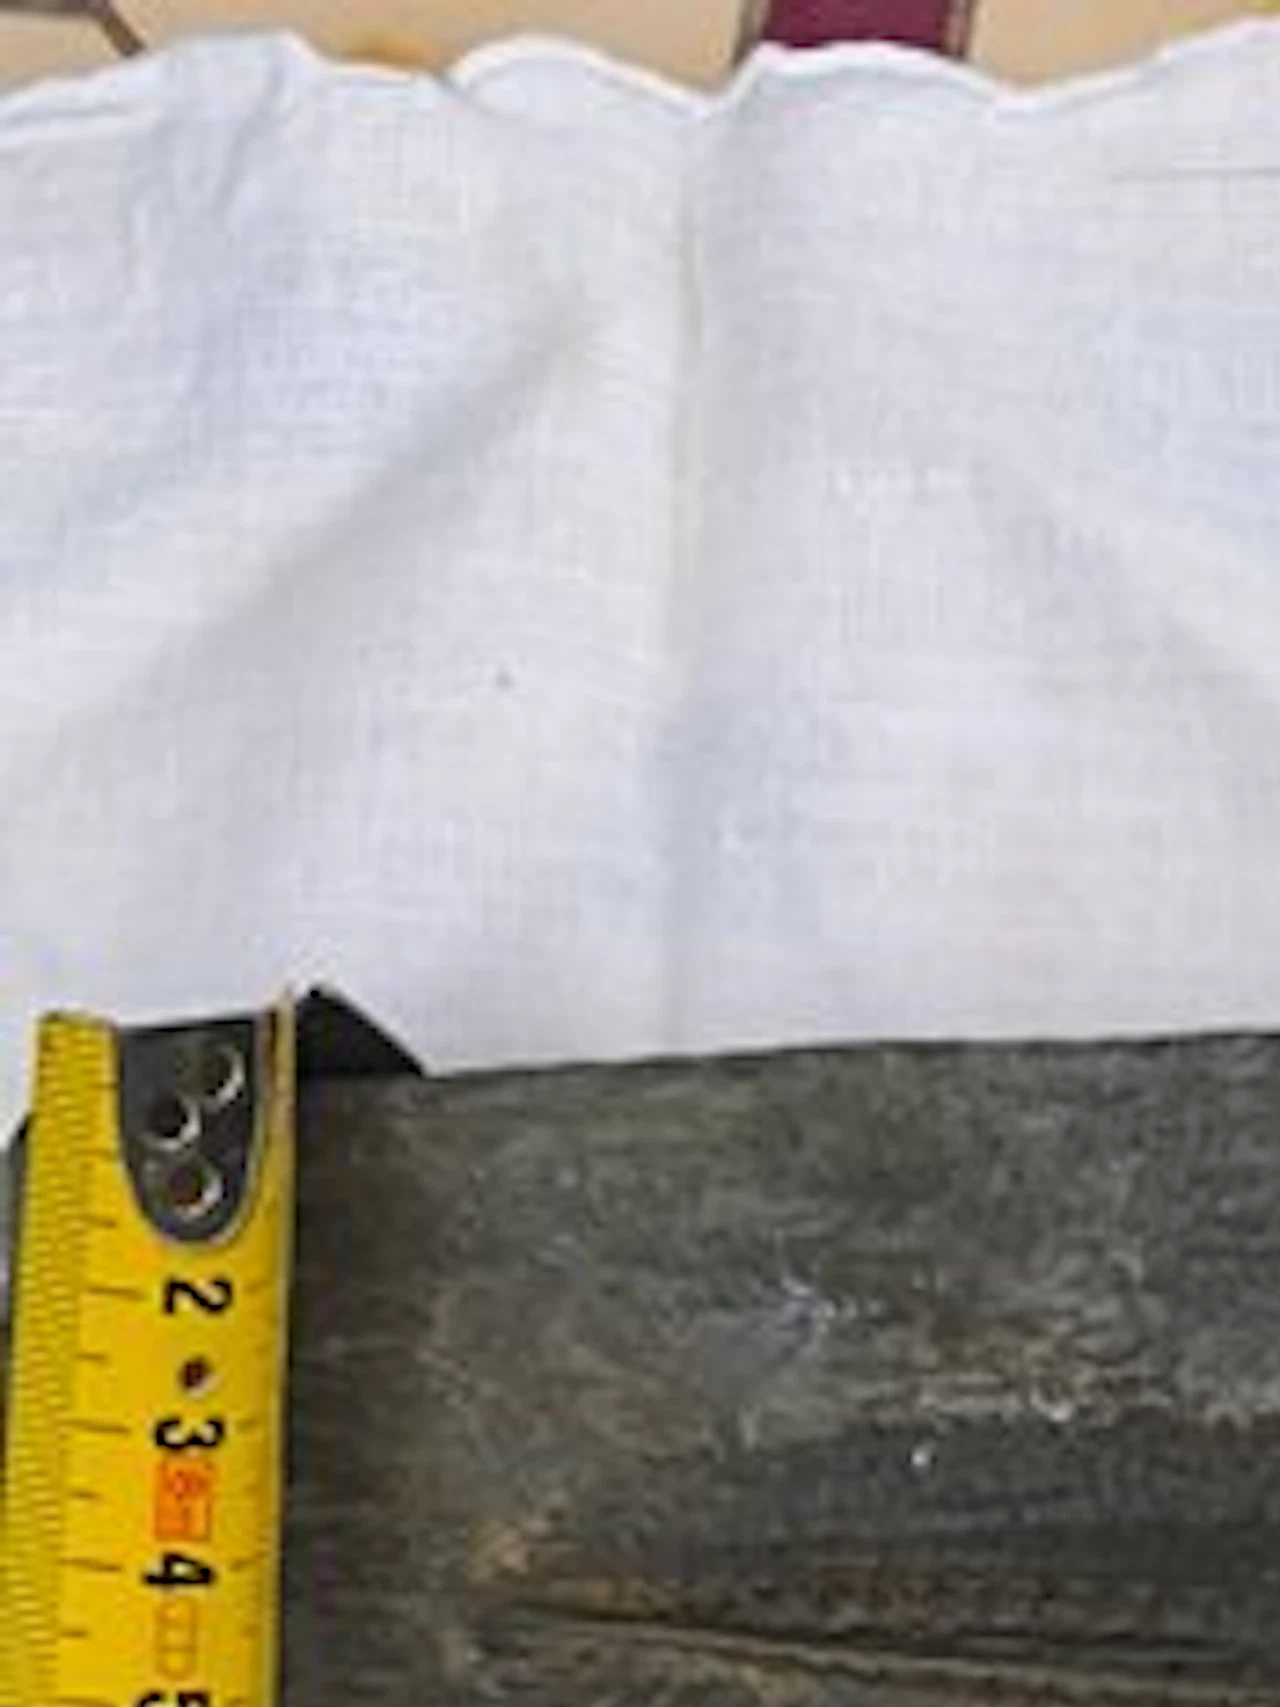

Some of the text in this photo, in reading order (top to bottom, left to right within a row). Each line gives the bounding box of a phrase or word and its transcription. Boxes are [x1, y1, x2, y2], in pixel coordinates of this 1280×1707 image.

[164, 1276, 234, 1316] 2
[155, 1416, 225, 1451] 3
[142, 1553, 217, 1588] 4
